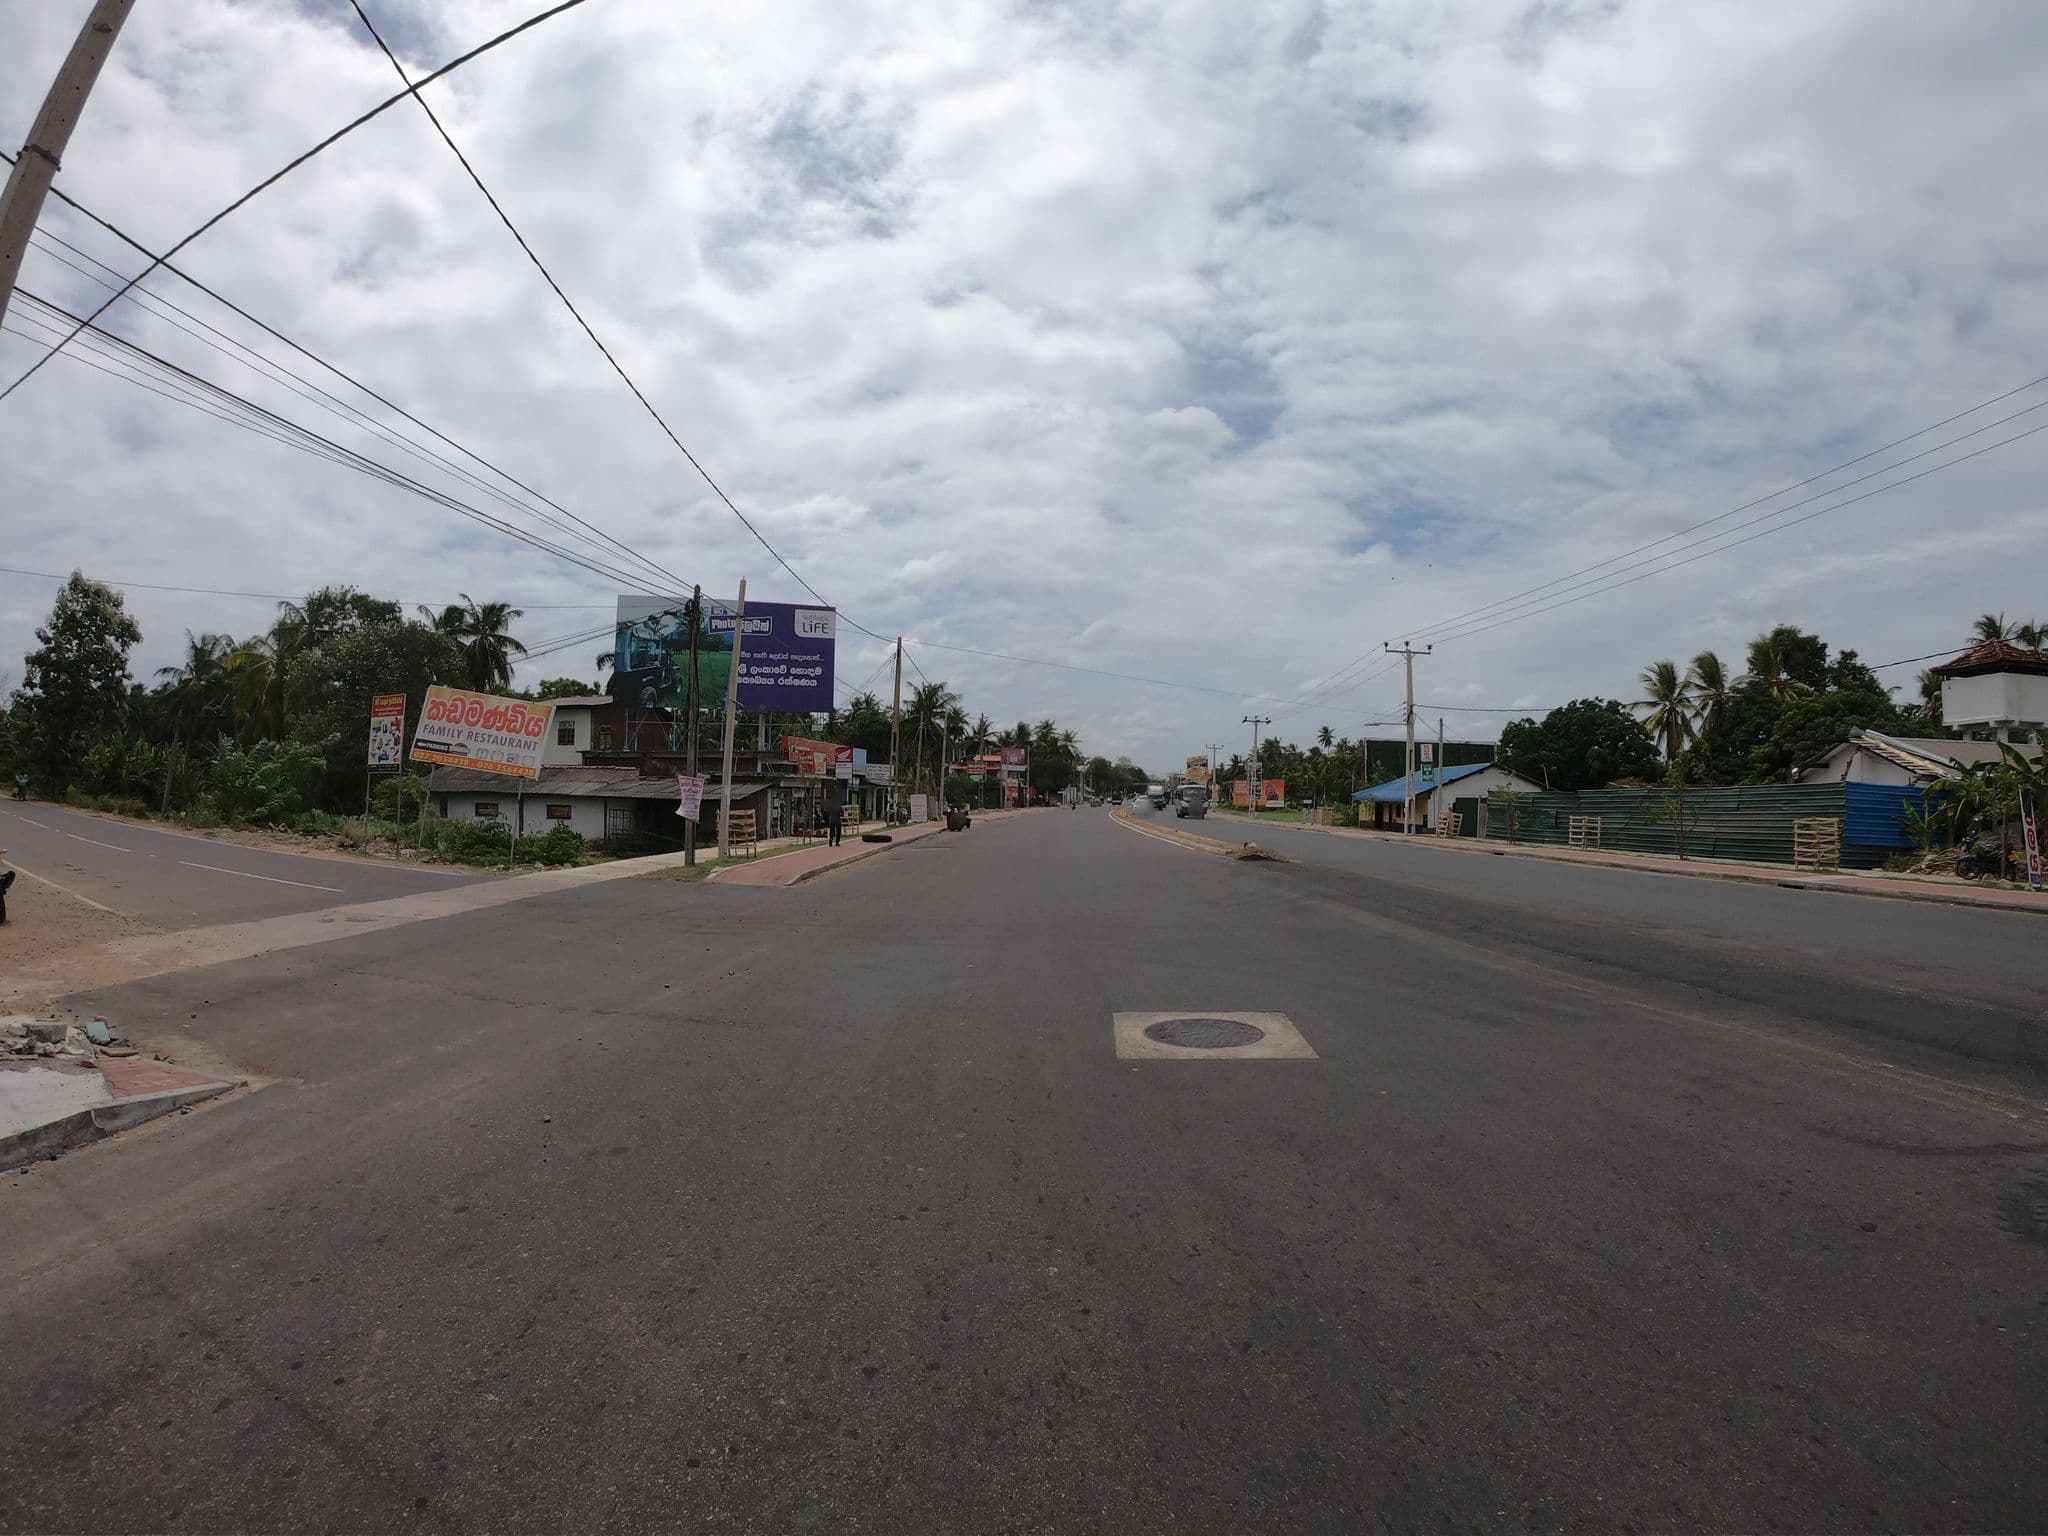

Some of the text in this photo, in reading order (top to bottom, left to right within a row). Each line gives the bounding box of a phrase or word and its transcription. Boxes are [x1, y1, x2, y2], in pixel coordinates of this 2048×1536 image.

[750, 664, 787, 675] ලංකාවේ
[778, 676, 817, 686] රක්ෂණය
[426, 696, 545, 737] කඩමණ්ඩිය
[423, 724, 539, 751] FAMILY RESTAURANT
[414, 750, 430, 759] 027
[476, 760, 494, 770] 076
